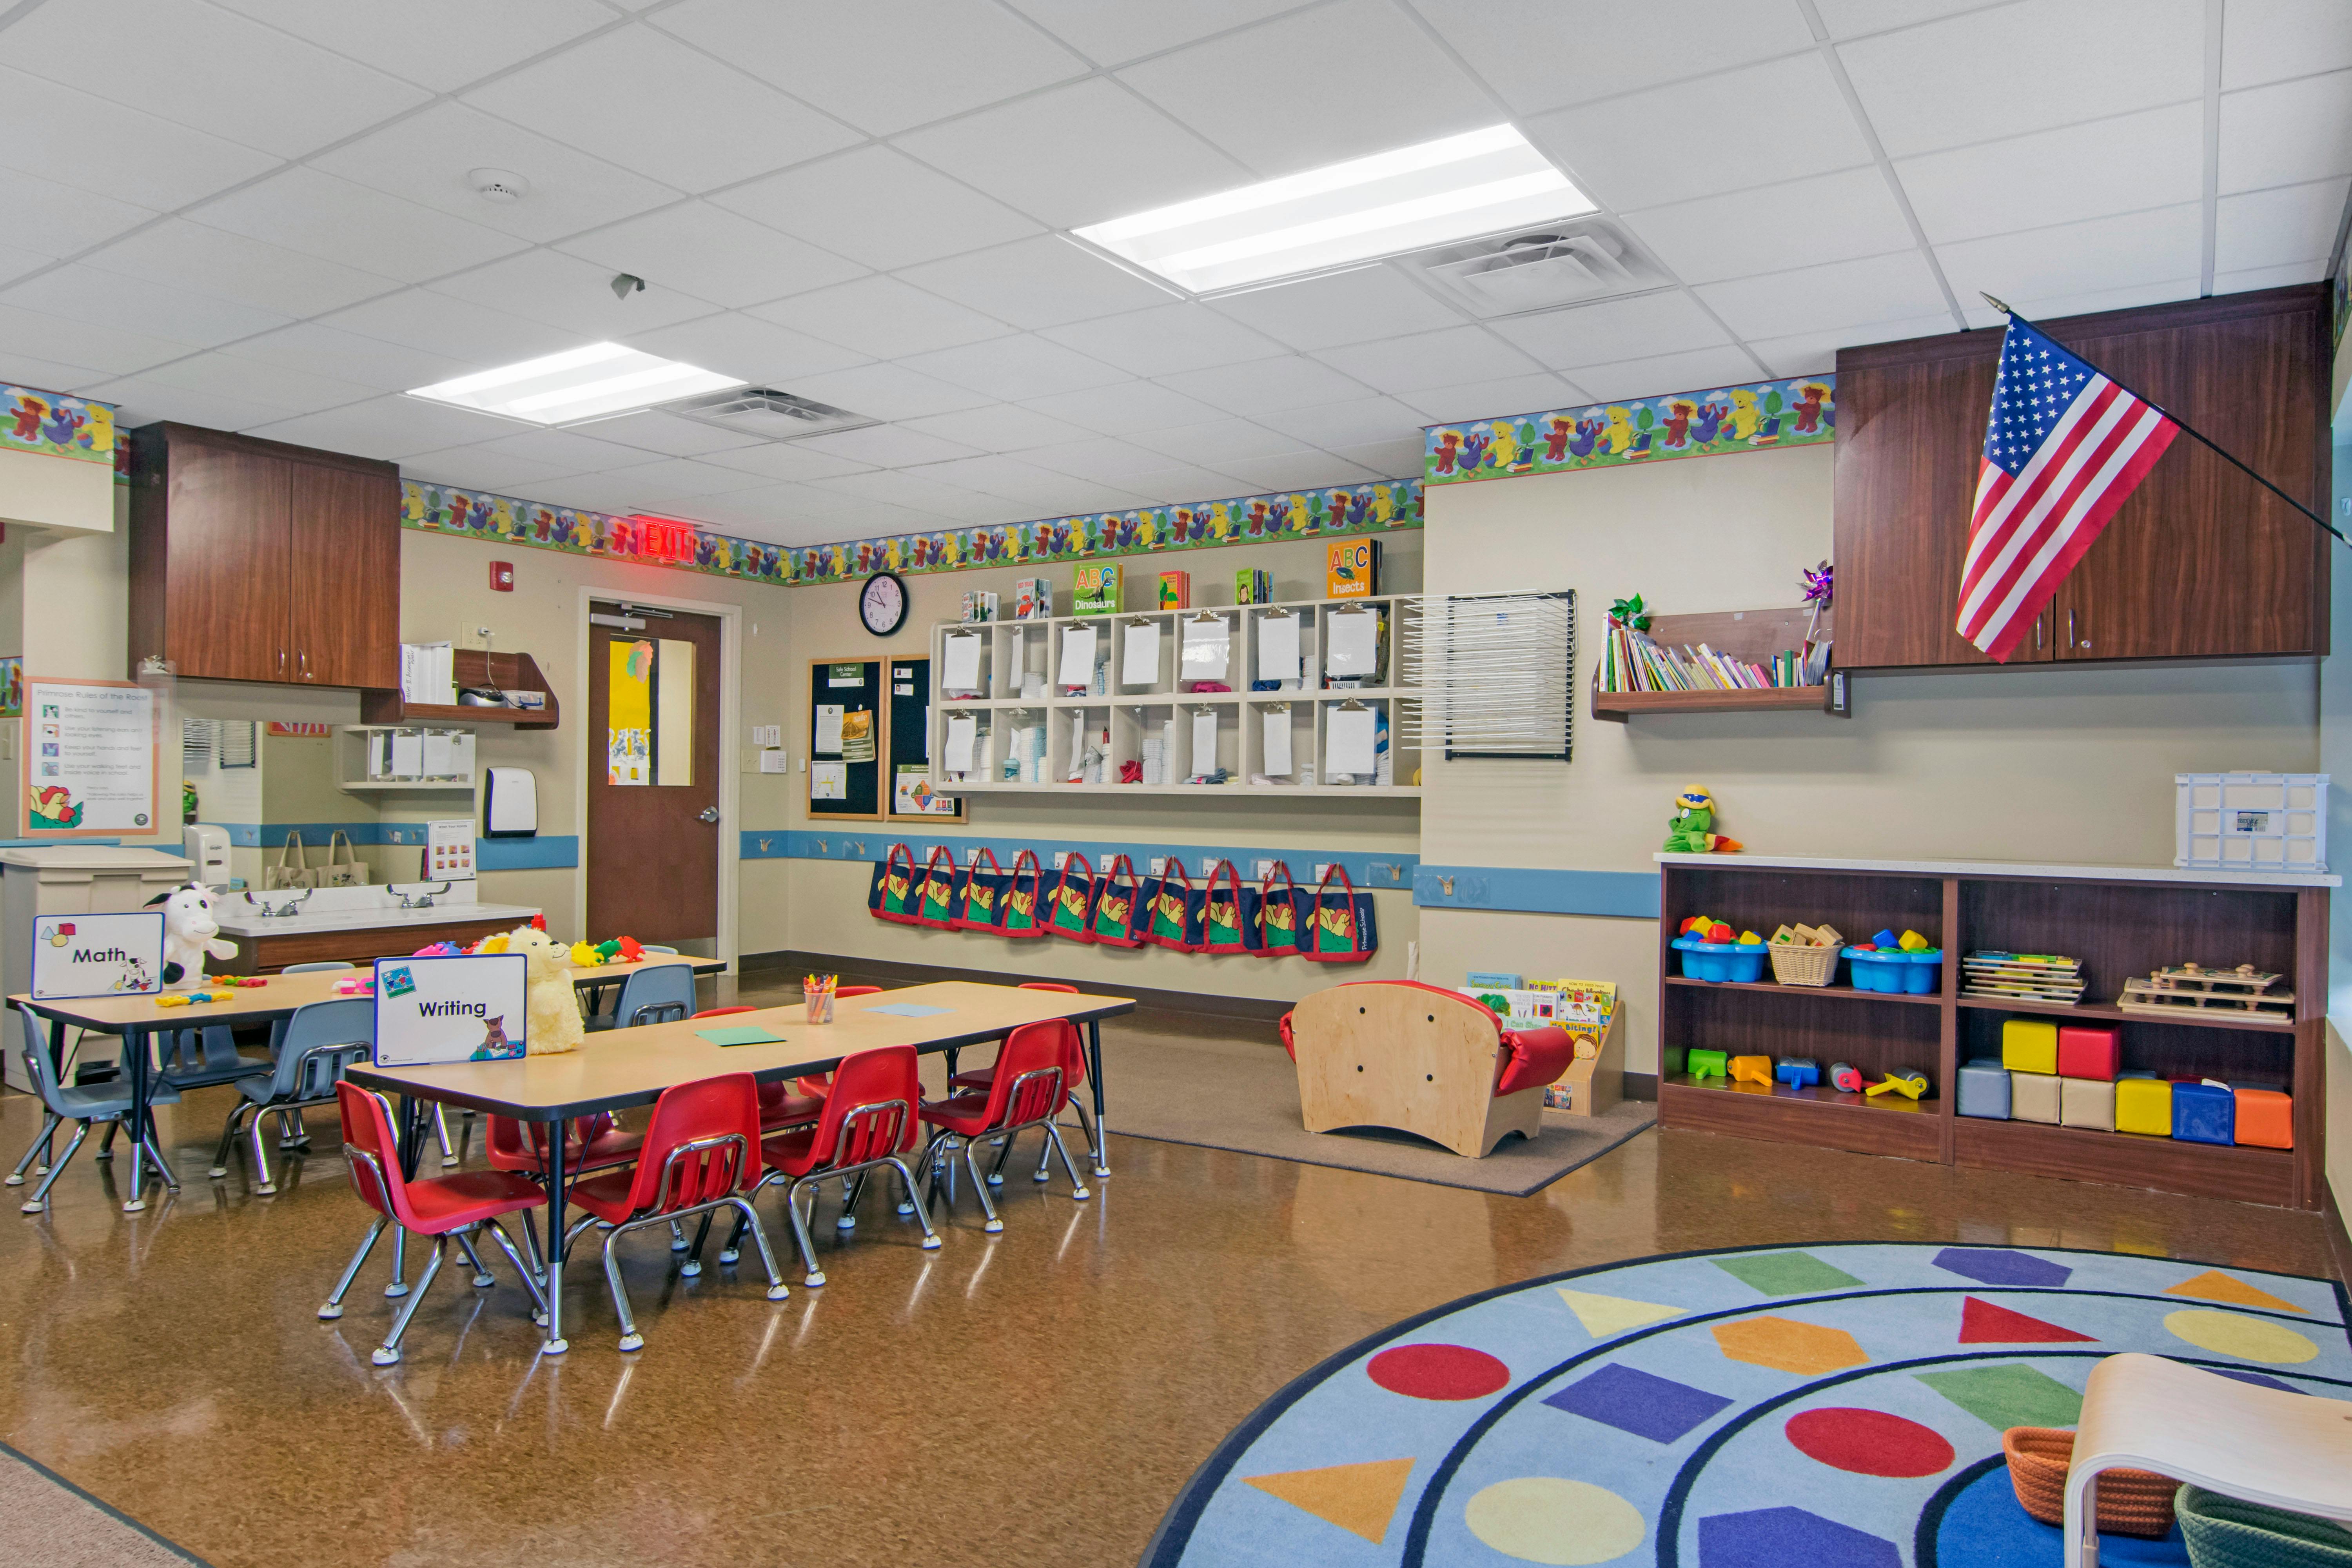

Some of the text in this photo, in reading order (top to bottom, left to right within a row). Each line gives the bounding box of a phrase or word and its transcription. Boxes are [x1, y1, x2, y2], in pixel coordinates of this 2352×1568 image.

[645, 522, 688, 559] EXIT
[1329, 545, 1368, 572] ABC
[1075, 567, 1114, 590] ABC
[1333, 581, 1364, 594] Insects
[1075, 600, 1115, 610] Dinosaurs
[38, 689, 73, 698] Primrose
[853, 713, 867, 723] safe
[72, 947, 126, 963] Math
[1471, 979, 1494, 989] Snappy
[419, 1000, 486, 1018] Writing
[1566, 1024, 1596, 1034] Biting!
